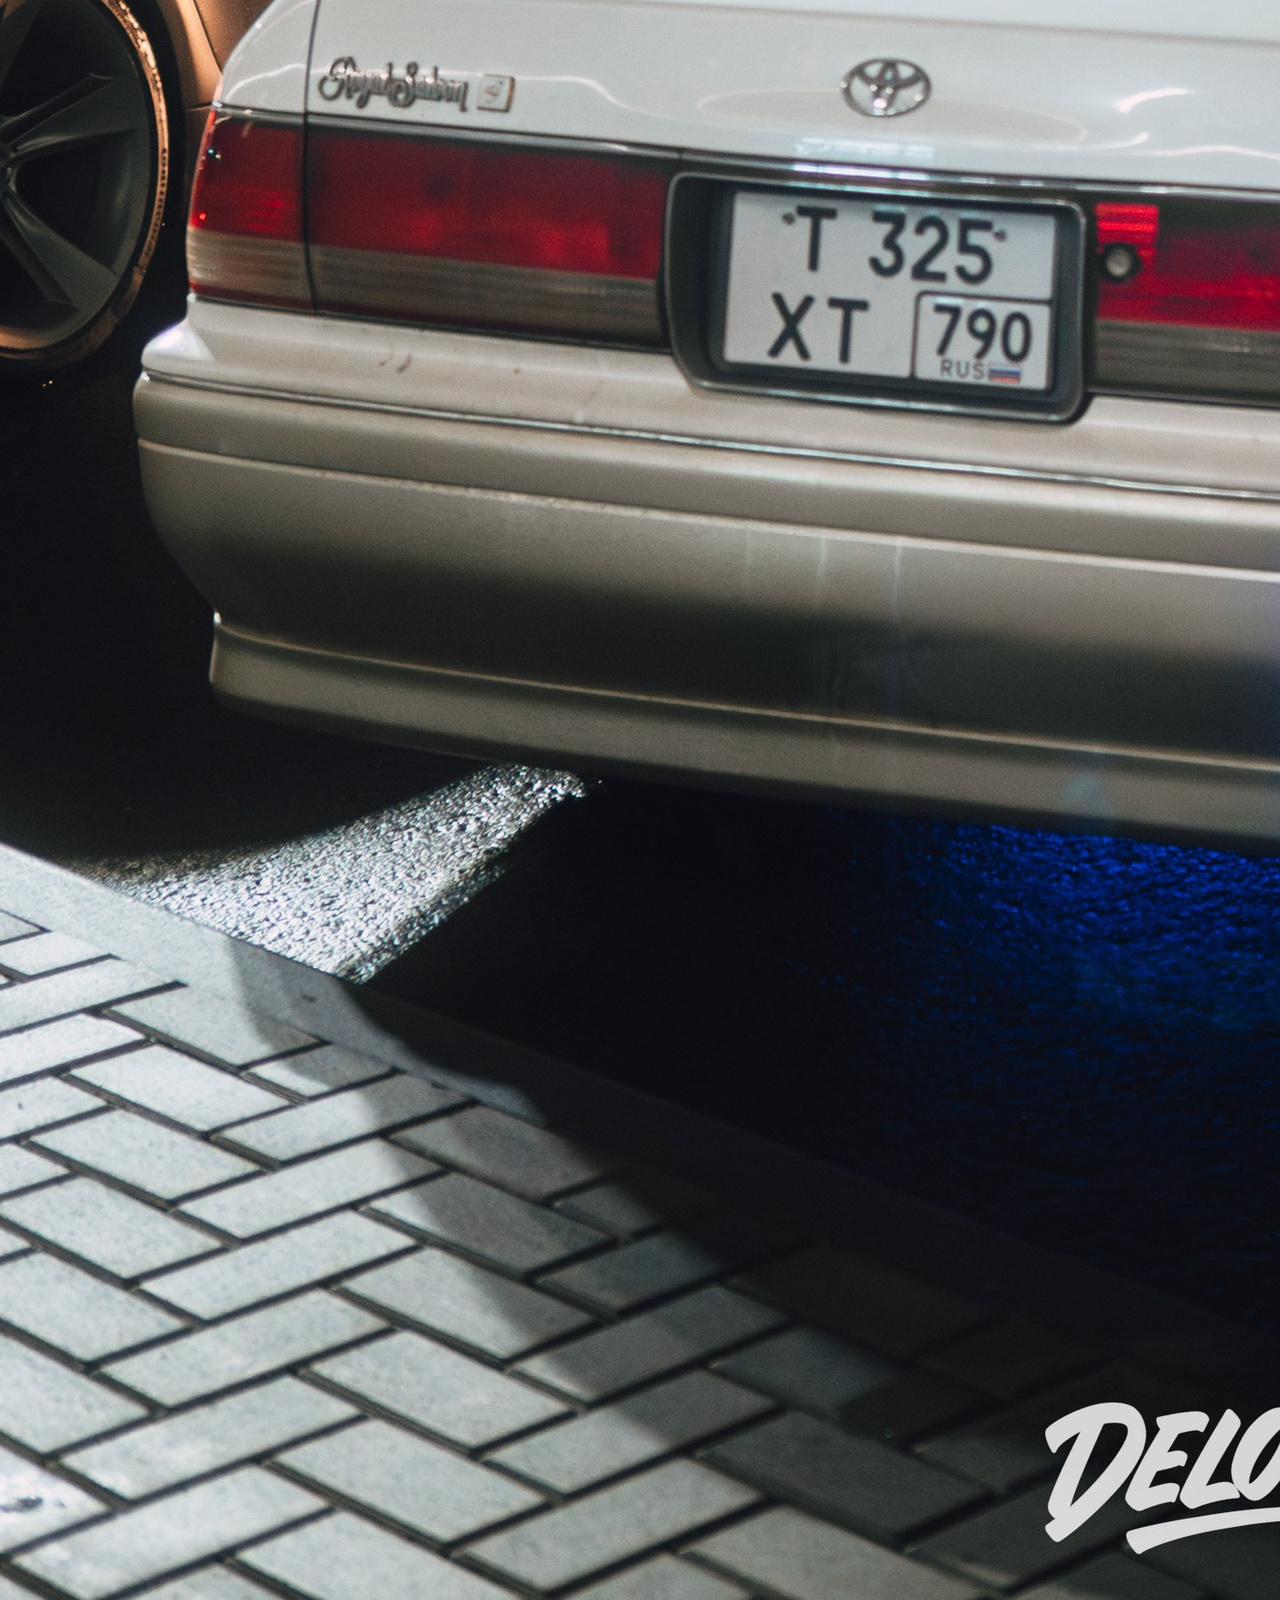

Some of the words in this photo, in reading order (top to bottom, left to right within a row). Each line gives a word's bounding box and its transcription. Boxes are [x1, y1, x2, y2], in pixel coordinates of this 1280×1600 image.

[868, 210, 994, 285] 325
[934, 302, 1032, 364] 790
[939, 362, 985, 380] RUS
